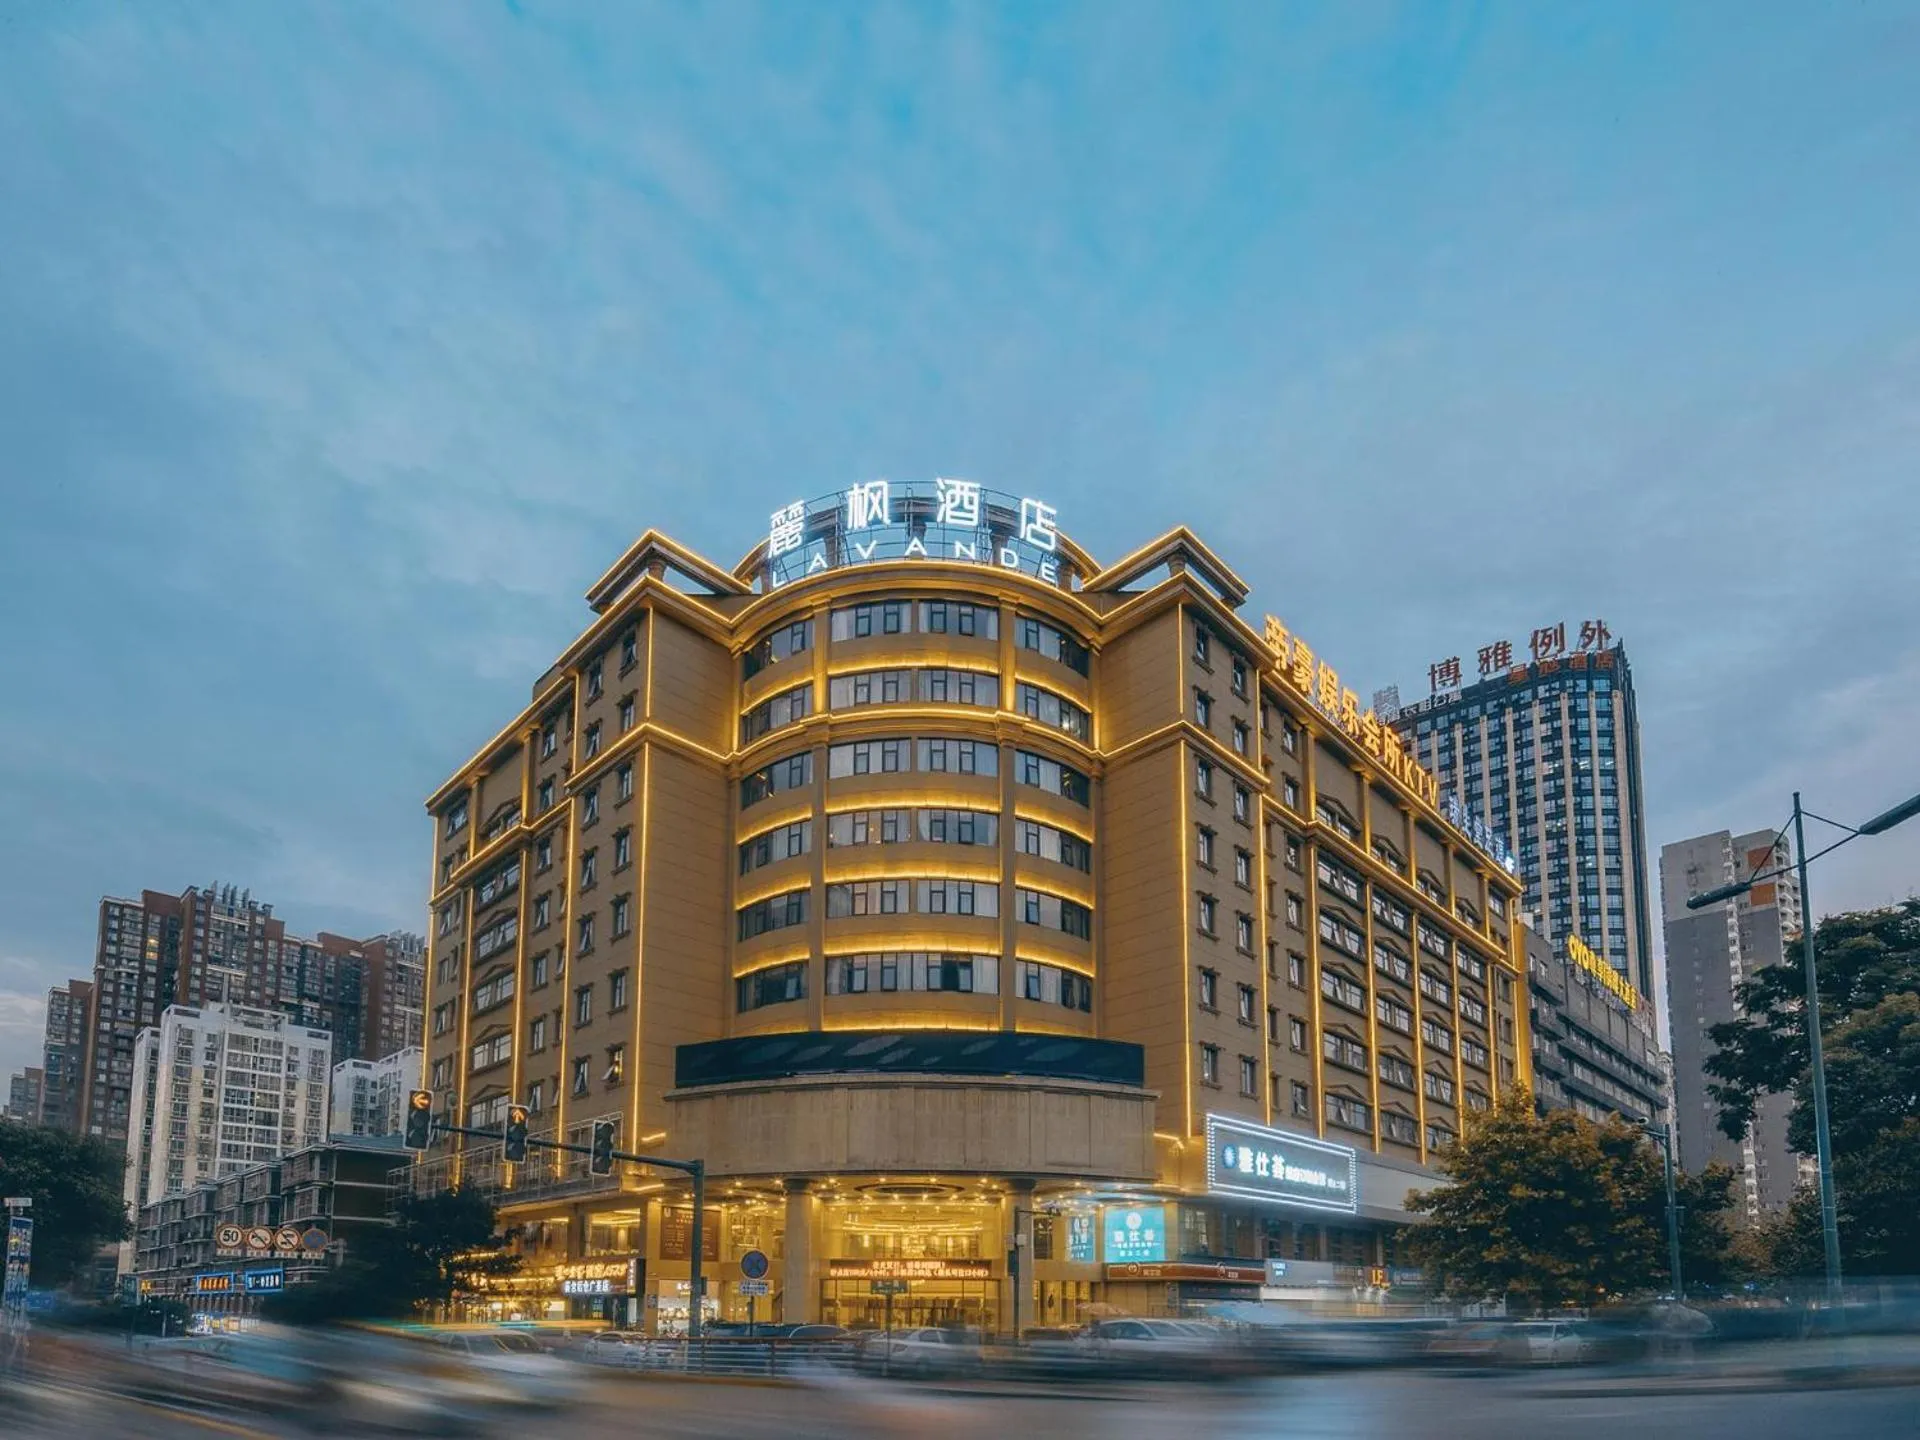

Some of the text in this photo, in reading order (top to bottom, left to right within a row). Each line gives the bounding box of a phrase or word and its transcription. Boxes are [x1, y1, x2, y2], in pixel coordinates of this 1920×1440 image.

[772, 538, 1058, 588] LAVANDE
[1428, 619, 1612, 692] 博雅例外
[223, 1229, 239, 1242] 50
